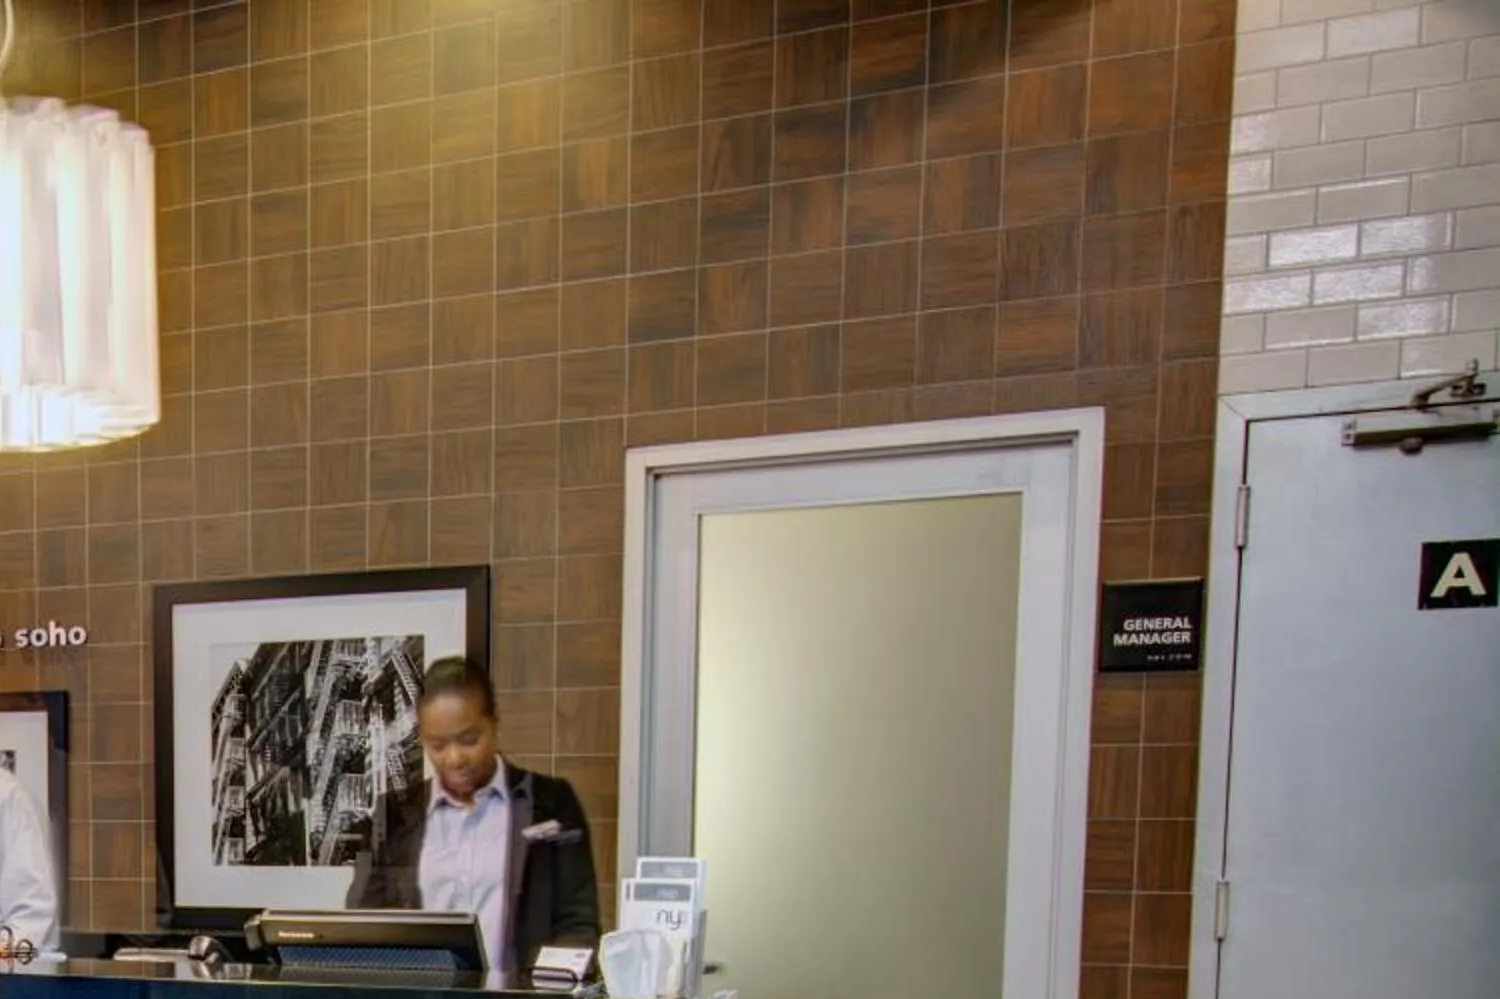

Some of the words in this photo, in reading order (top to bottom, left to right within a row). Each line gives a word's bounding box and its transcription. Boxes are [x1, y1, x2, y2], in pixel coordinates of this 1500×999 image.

[1430, 551, 1487, 597] A
[14, 620, 87, 648] soho
[1123, 617, 1192, 631] GENERAL
[1113, 631, 1191, 647] MANAGER
[657, 909, 682, 931] ny
